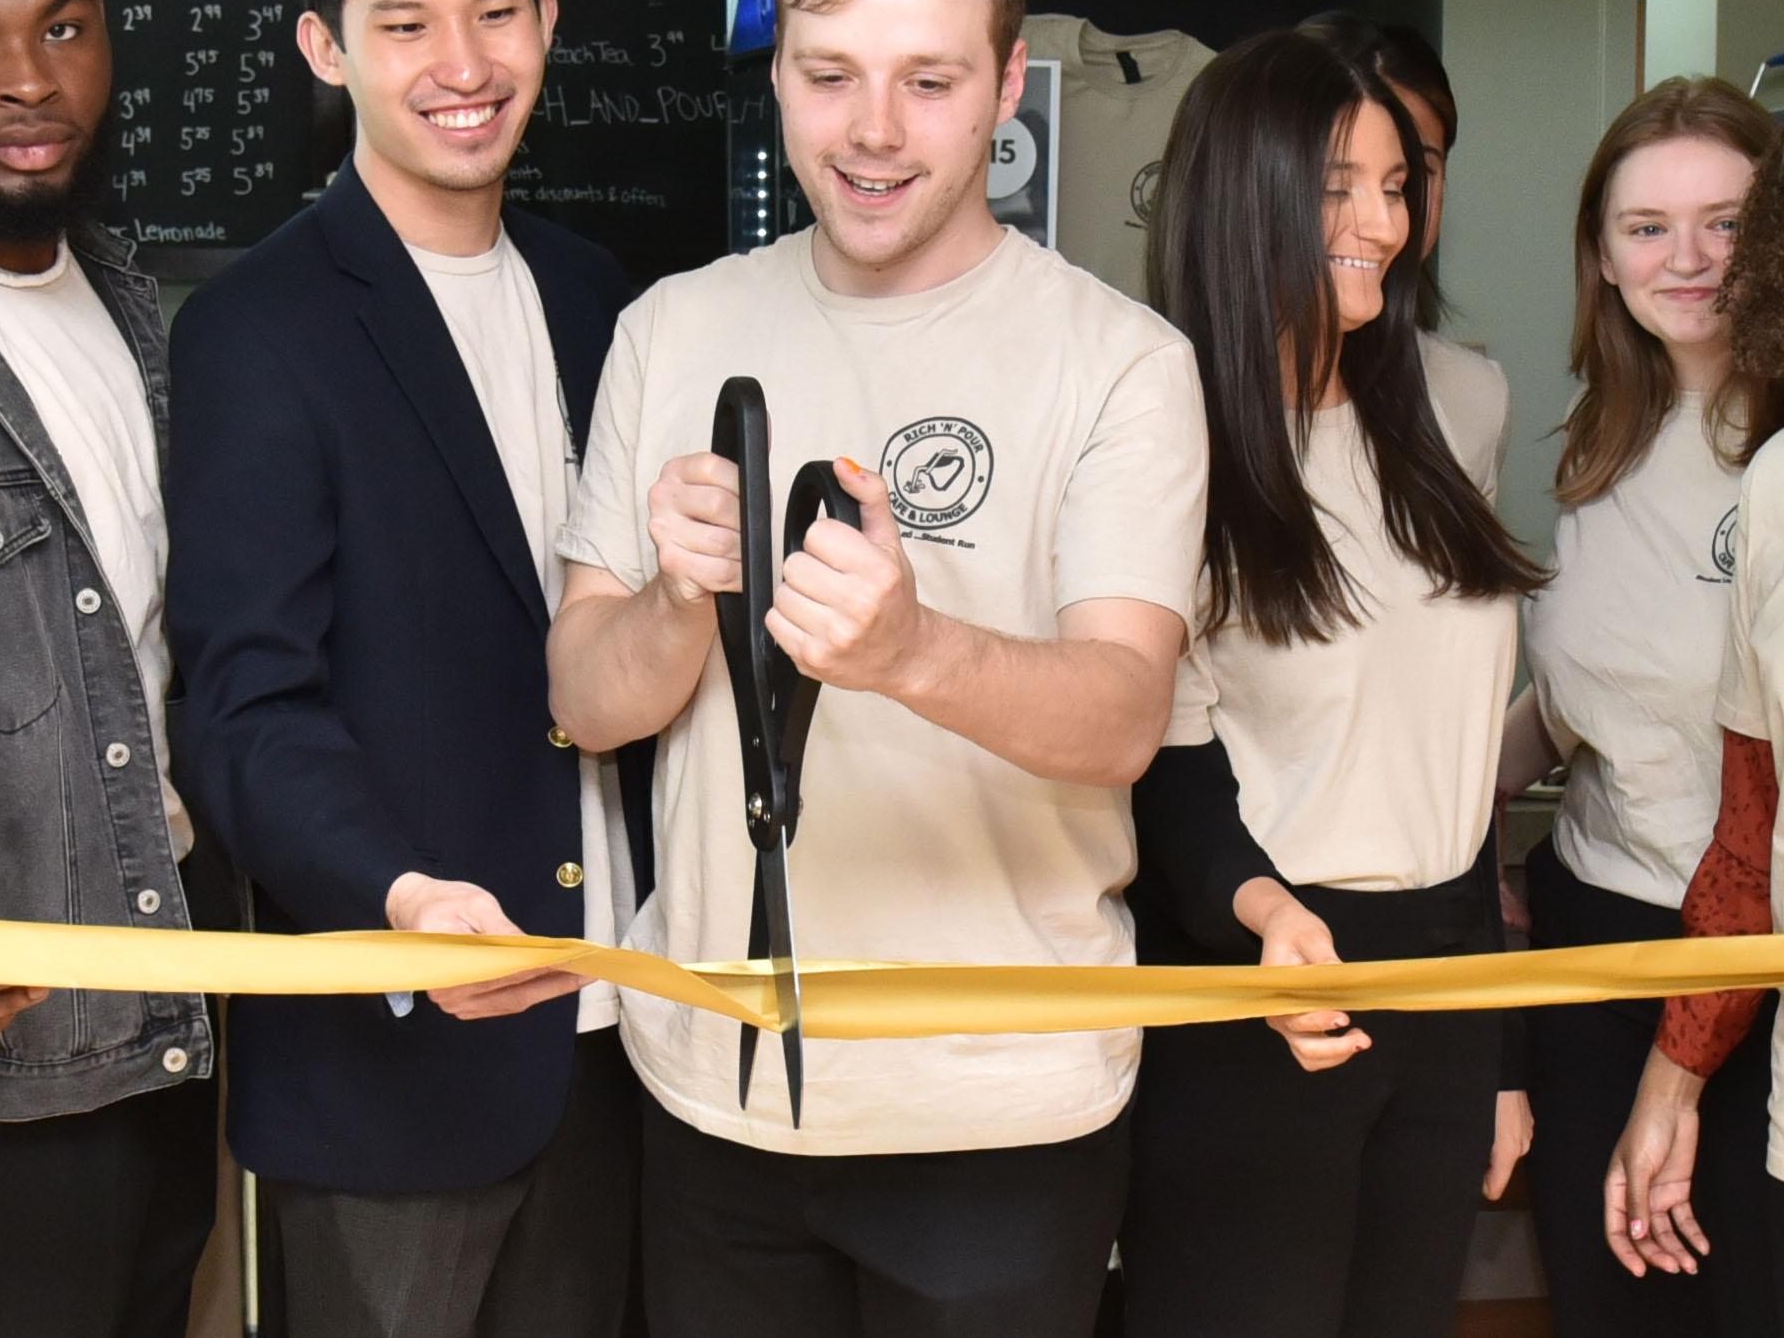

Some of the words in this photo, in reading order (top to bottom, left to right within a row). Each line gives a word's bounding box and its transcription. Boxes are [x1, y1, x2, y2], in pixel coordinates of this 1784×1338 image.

[133, 217, 227, 244] Lemonade
[903, 423, 937, 444] RICH
[956, 425, 985, 454] POUR
[887, 490, 910, 518] CAFE
[918, 502, 969, 524] LOUNGE
